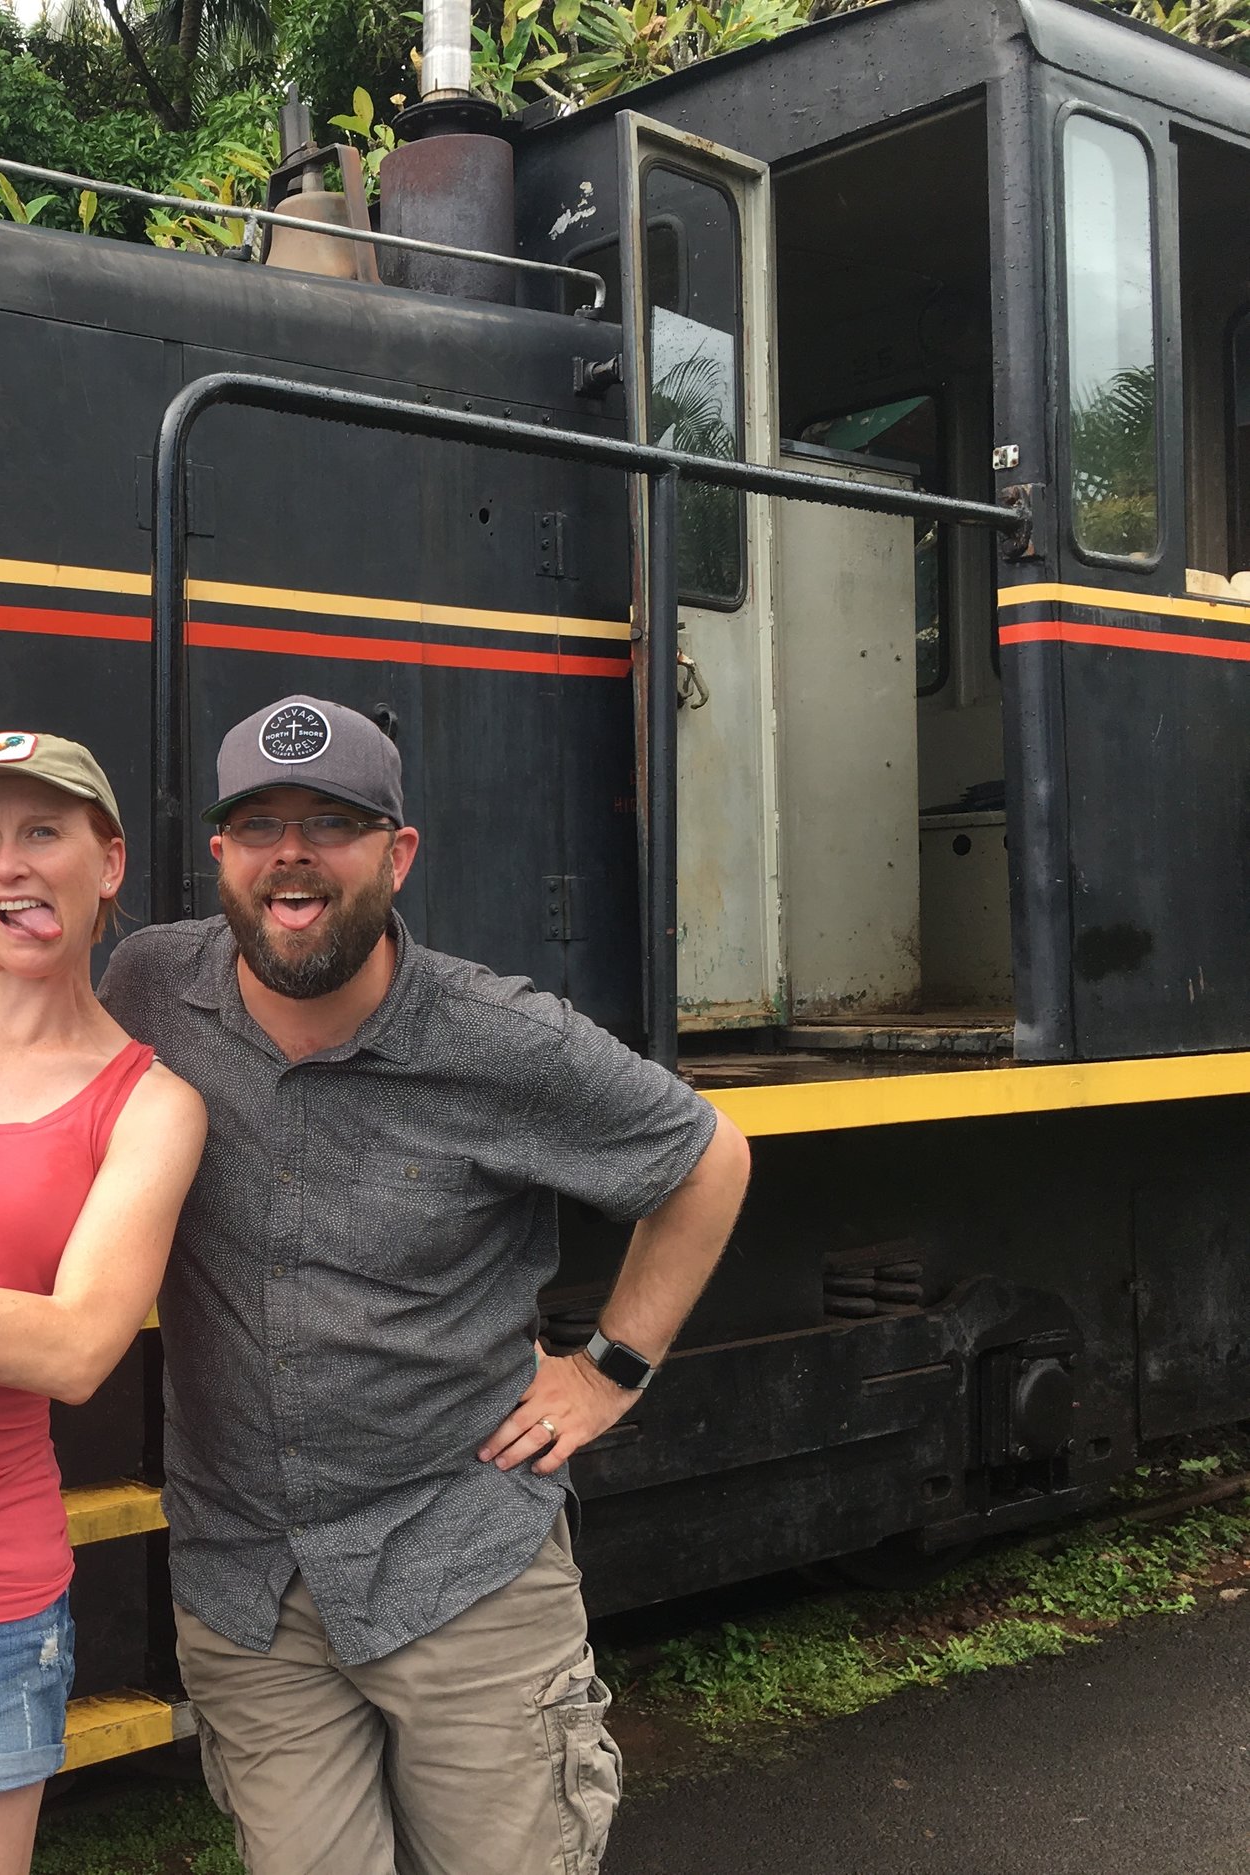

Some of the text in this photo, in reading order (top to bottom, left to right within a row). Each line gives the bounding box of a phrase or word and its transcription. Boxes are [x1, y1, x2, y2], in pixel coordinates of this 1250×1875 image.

[270, 709, 319, 729] CALVARY
[265, 731, 289, 740] NORTH
[272, 739, 316, 752] CHAPEL
